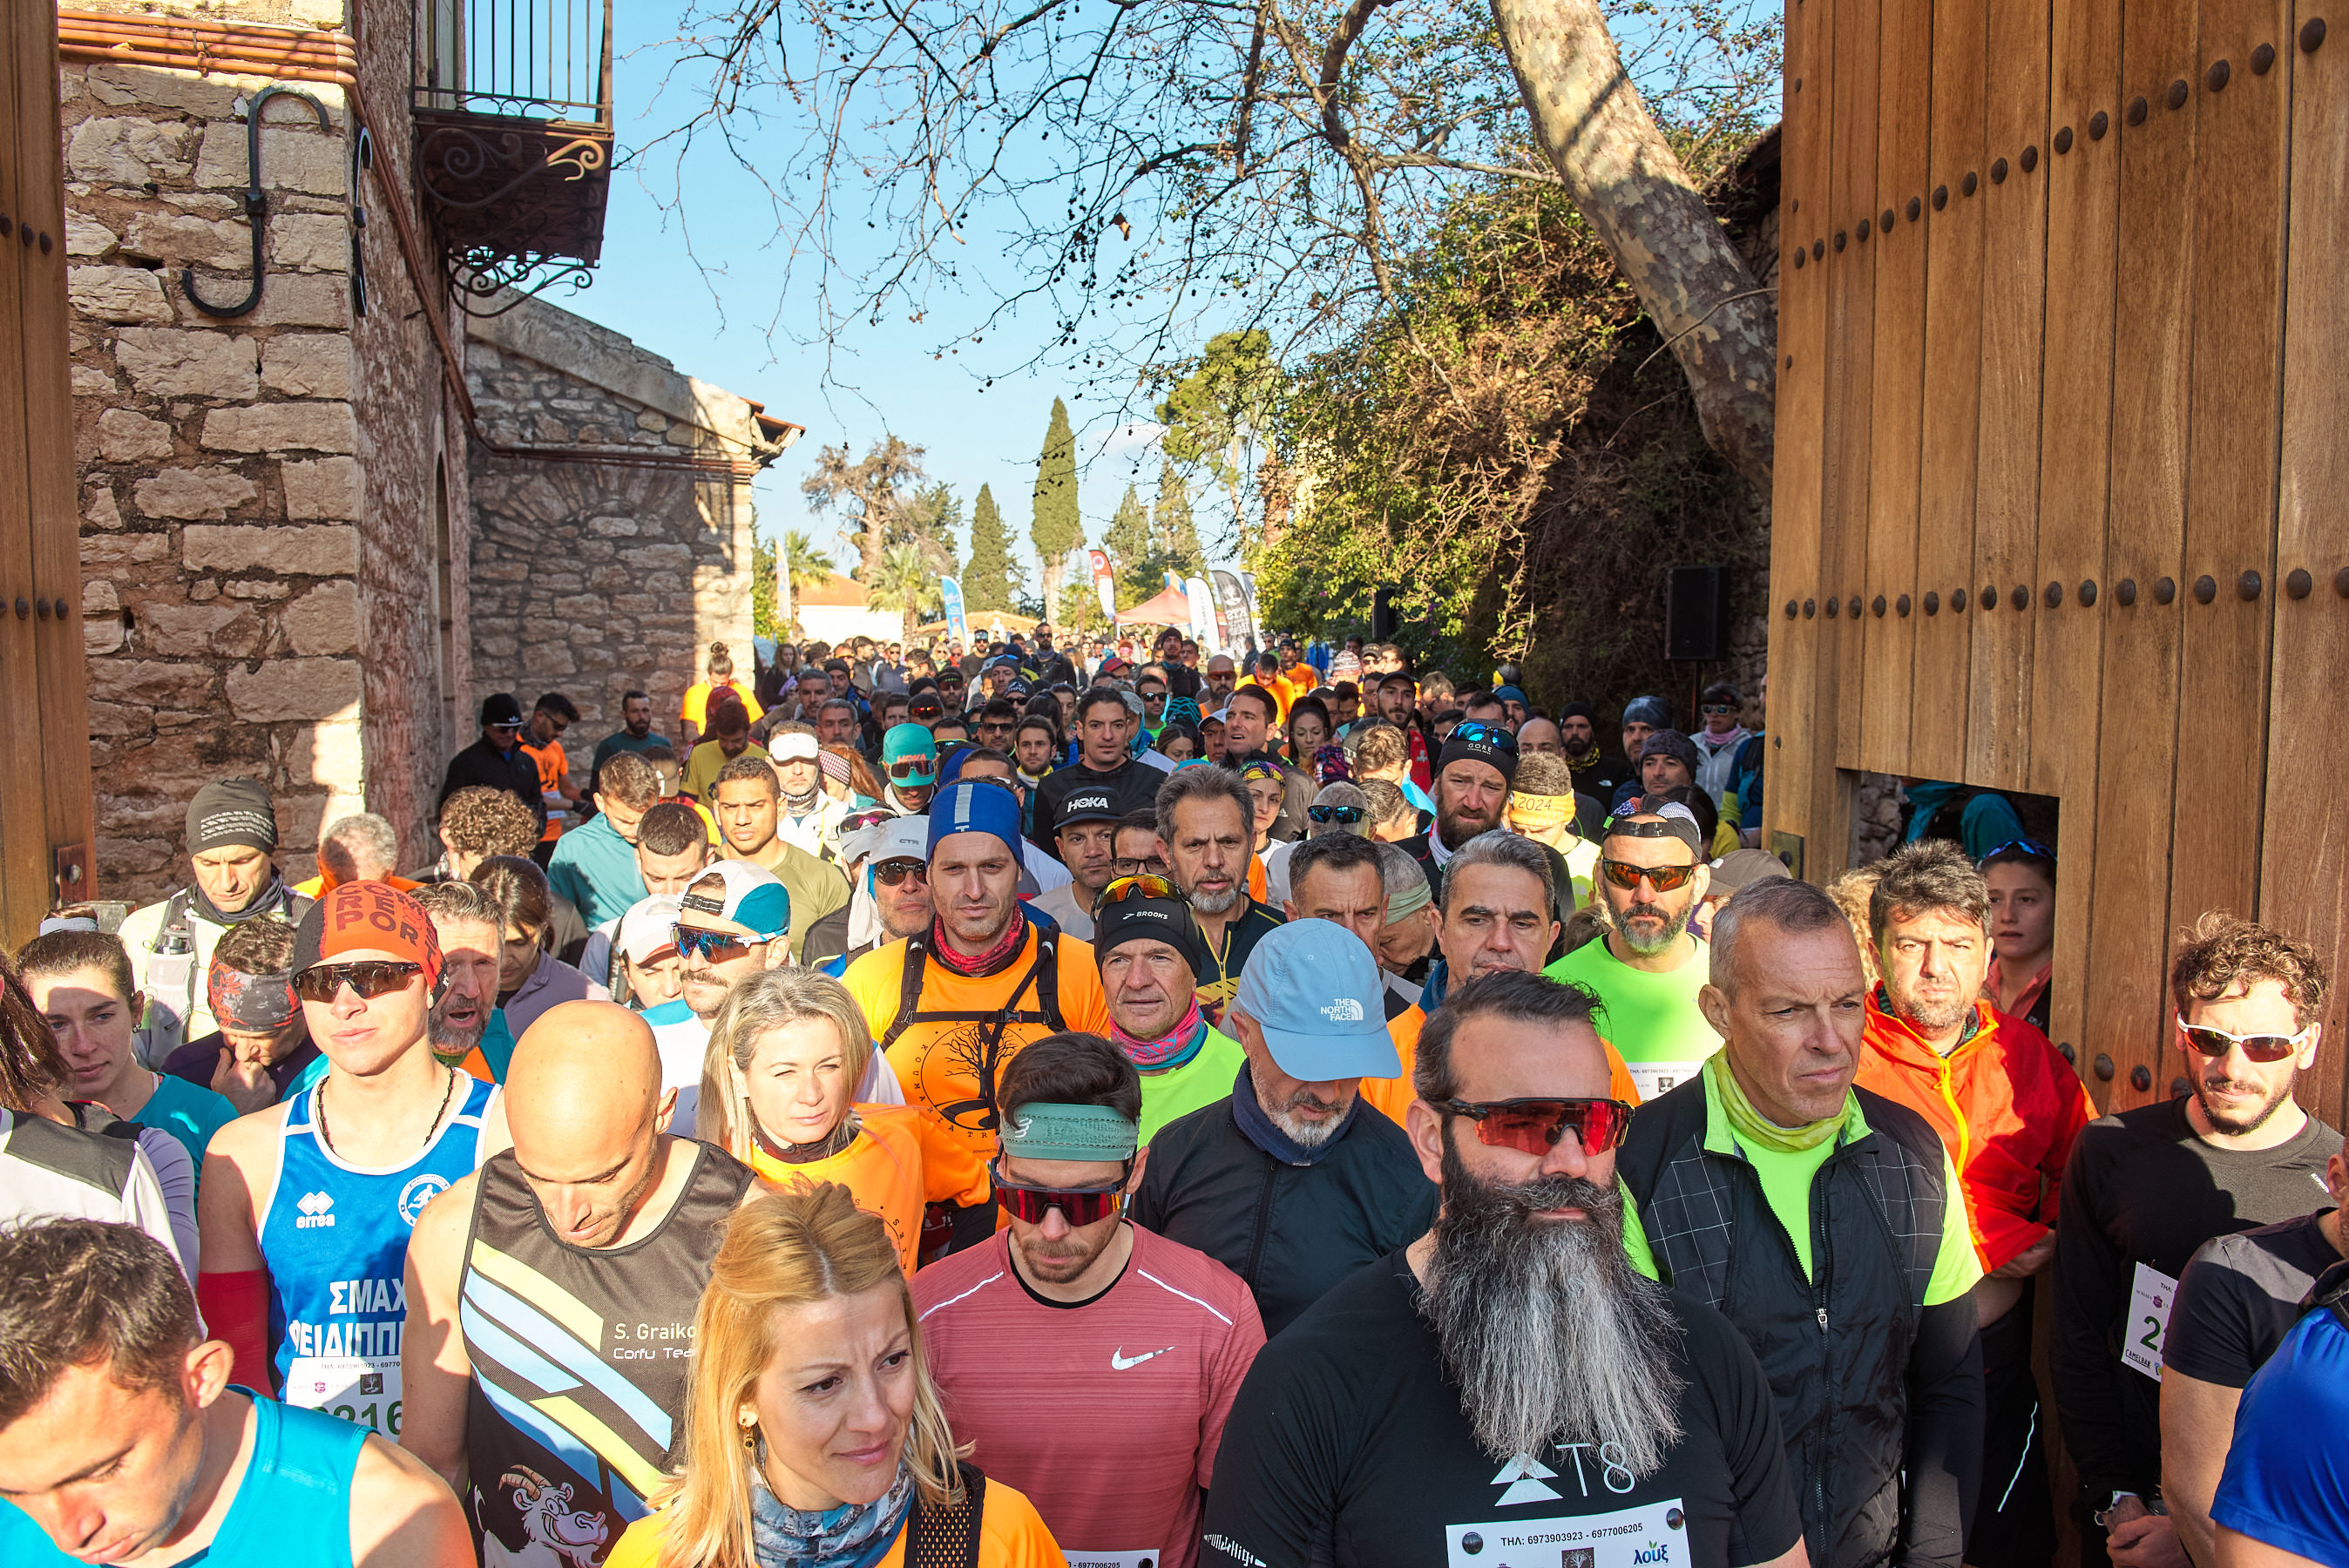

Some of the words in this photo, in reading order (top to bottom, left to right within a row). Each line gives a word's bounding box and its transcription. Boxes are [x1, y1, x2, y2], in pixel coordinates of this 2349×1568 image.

[1468, 743, 1492, 753] GORE
[1067, 797, 1108, 813] HOKA
[1518, 797, 1552, 811] 2024
[1136, 911, 1168, 920] BROOKS
[1334, 998, 1351, 1007] THE
[1320, 1006, 1351, 1015] NORTH
[1330, 1013, 1351, 1022] FACE
[613, 1323, 629, 1340] S.
[637, 1322, 697, 1340] Graiko
[613, 1348, 655, 1359] Corfu
[2126, 1348, 2151, 1369] CAMELBAK
[1556, 1441, 1635, 1497] T8
[1500, 1537, 1525, 1547] ΤΗΛ:
[1527, 1531, 1583, 1545] 6973903923
[1592, 1523, 1643, 1539] 6977006205
